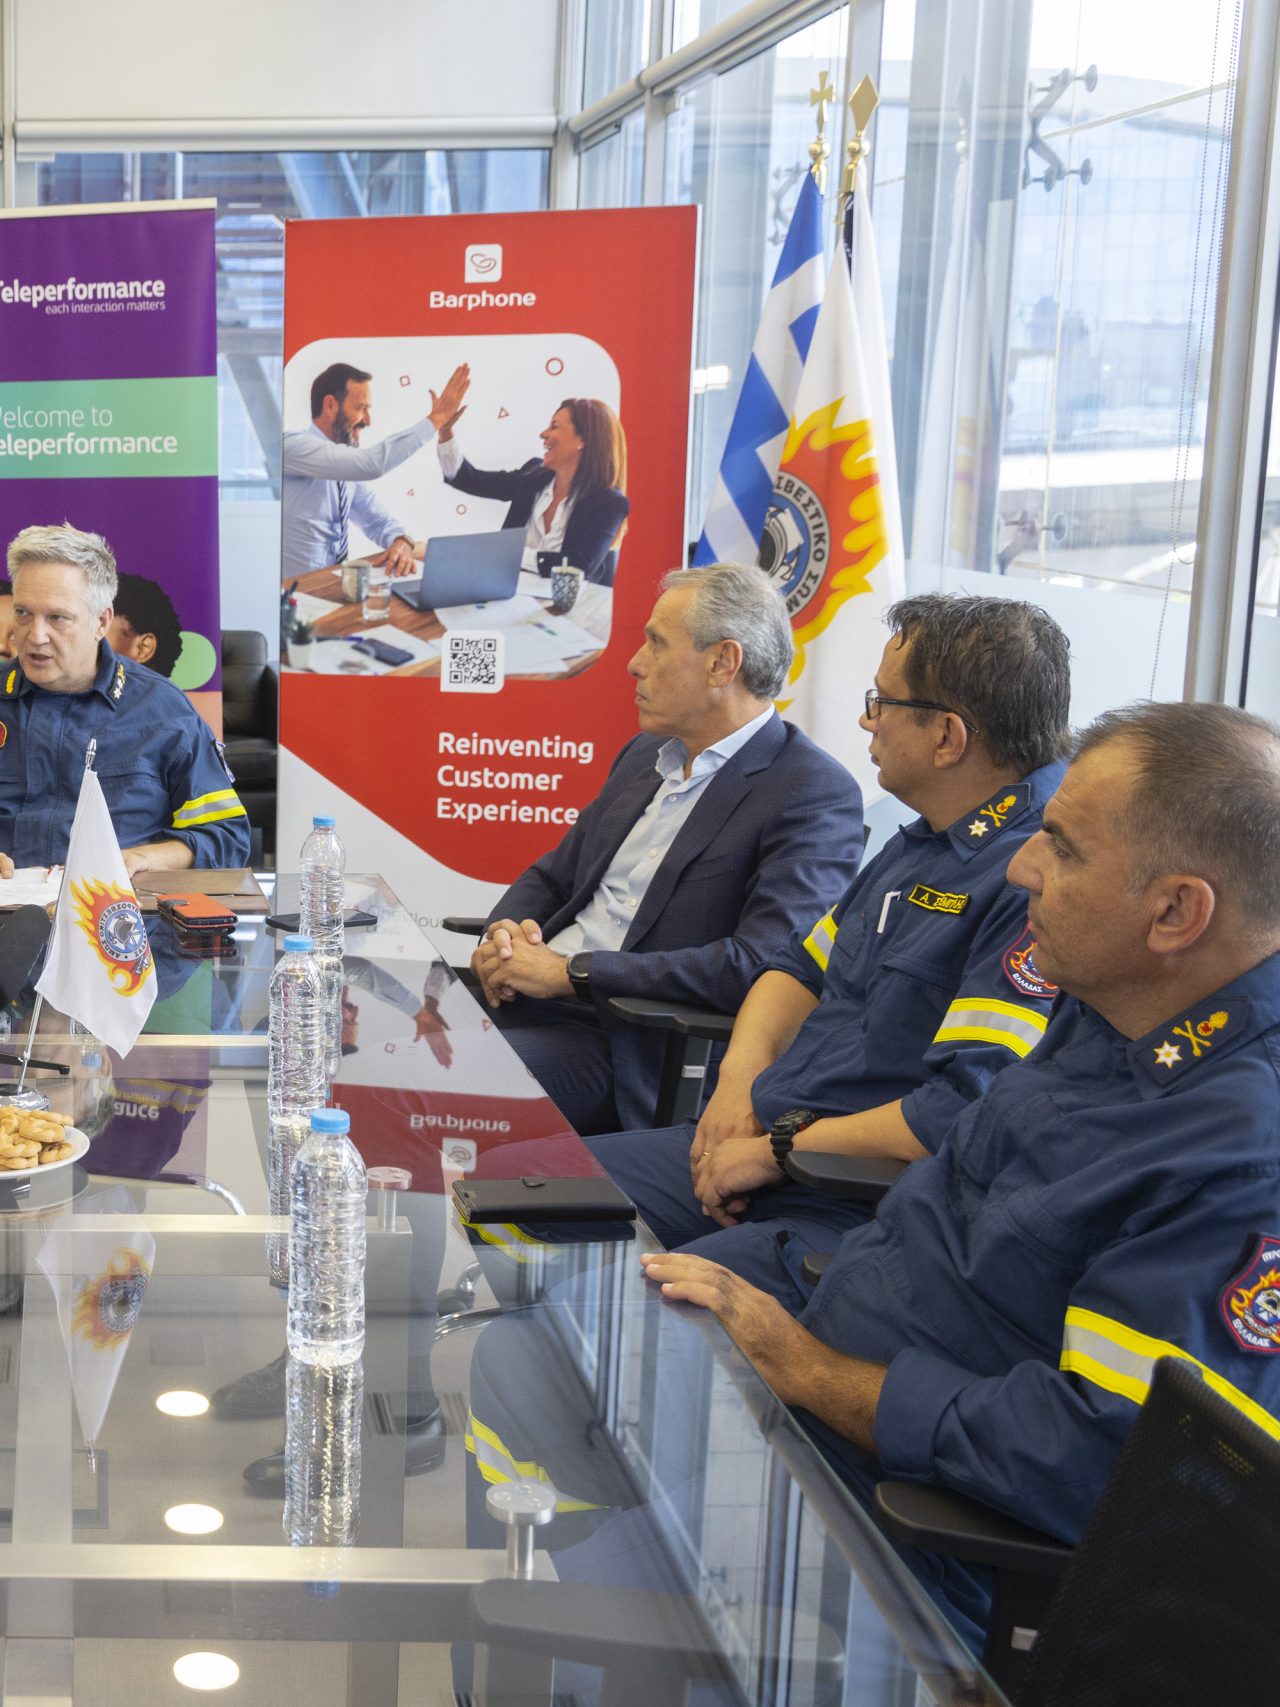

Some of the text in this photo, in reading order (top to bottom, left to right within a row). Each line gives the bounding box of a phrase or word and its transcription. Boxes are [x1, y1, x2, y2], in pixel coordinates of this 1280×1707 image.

[45, 301, 166, 314] each interaction matters
[429, 290, 537, 311] Barphone
[91, 406, 113, 427] to
[438, 732, 593, 764] Reinventing
[437, 765, 563, 791] Customer
[436, 797, 580, 825] Experience
